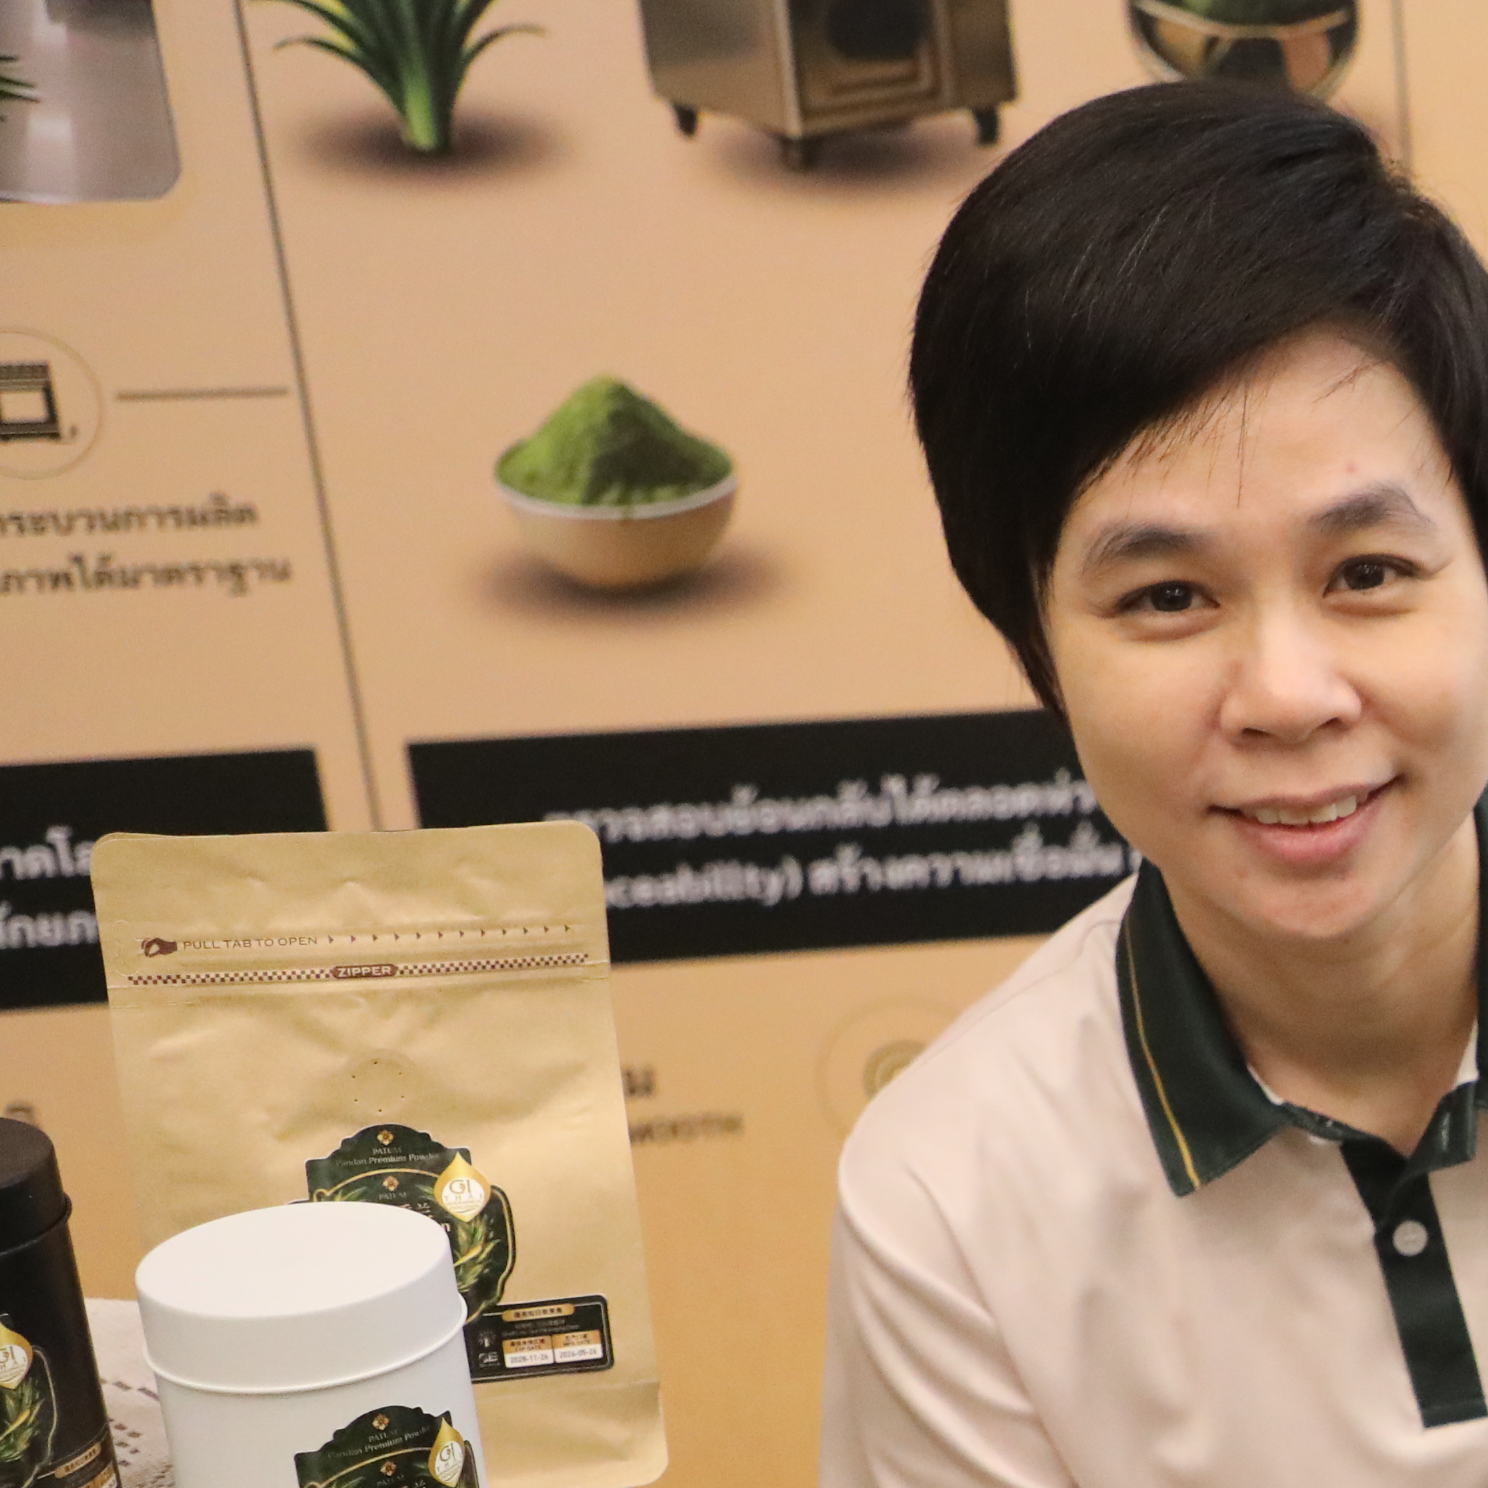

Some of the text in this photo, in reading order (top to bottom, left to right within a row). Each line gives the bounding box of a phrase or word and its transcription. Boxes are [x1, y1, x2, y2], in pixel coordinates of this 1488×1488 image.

[0, 492, 258, 536] ระบวนการผลิต
[603, 853, 804, 908] ceability)
[183, 936, 318, 951] PULL TAB TO OPEN
[337, 965, 393, 977] ZIPPER
